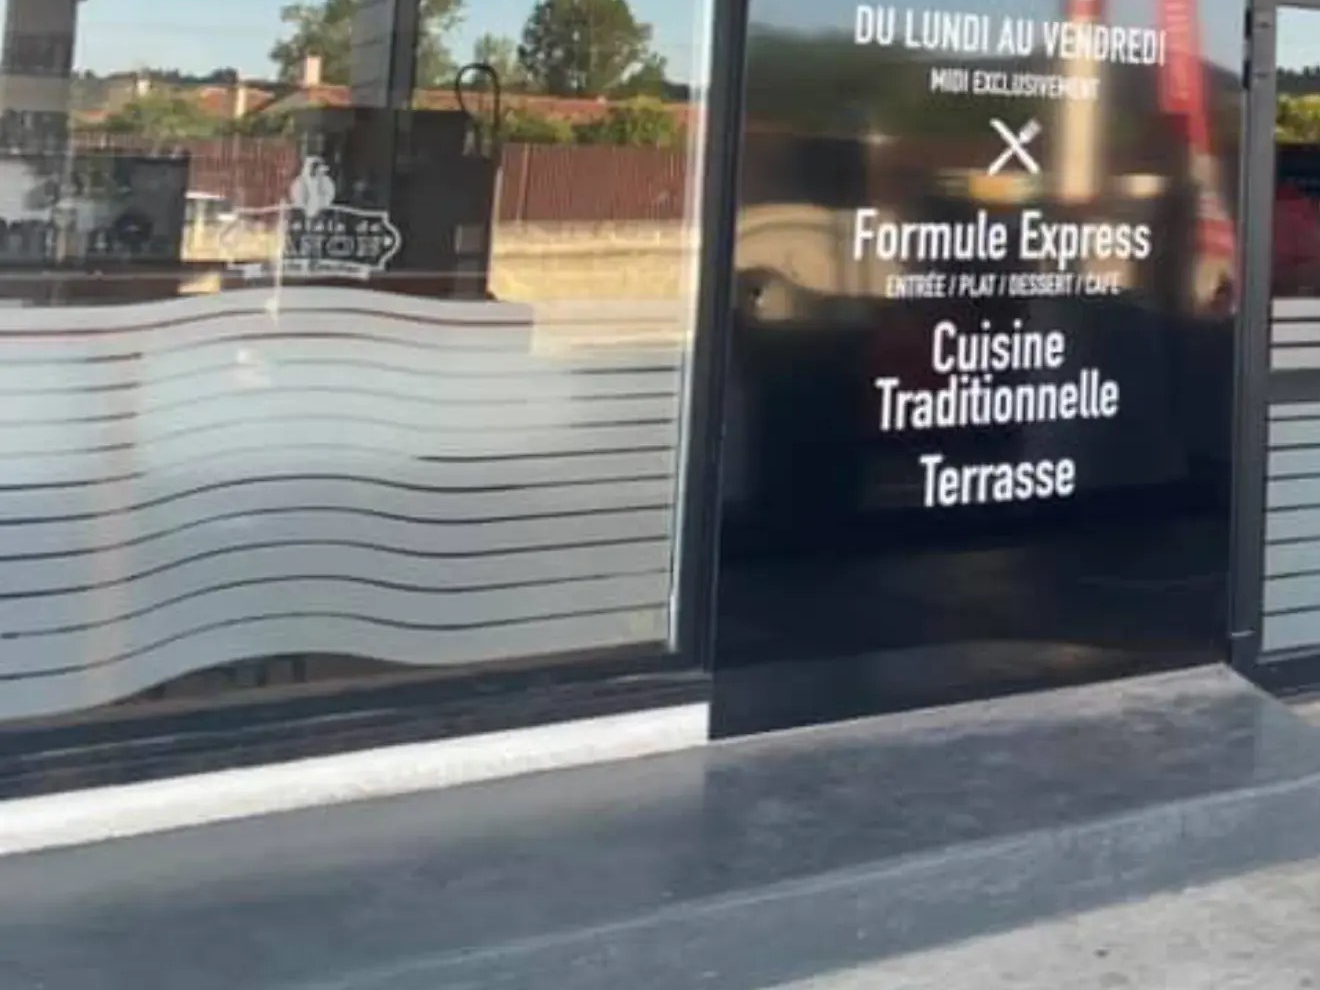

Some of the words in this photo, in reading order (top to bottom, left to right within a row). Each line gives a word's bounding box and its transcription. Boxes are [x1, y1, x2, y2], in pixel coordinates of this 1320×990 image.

[854, 4, 896, 46] DU
[904, 8, 989, 55] LUNDI
[997, 15, 1033, 58] AU
[1043, 21, 1166, 67] VENDREDI
[930, 67, 969, 94] MIDI
[972, 70, 1100, 101] EXCLUSIVEMENT
[853, 208, 1008, 261] Formule
[1019, 210, 1152, 271] Express
[958, 273, 996, 297] PLAT
[1007, 272, 1072, 297] DESSERT
[932, 319, 1066, 374] Cuisine
[875, 368, 1120, 432] Traditionnelle
[919, 454, 1077, 508] Terrasse
